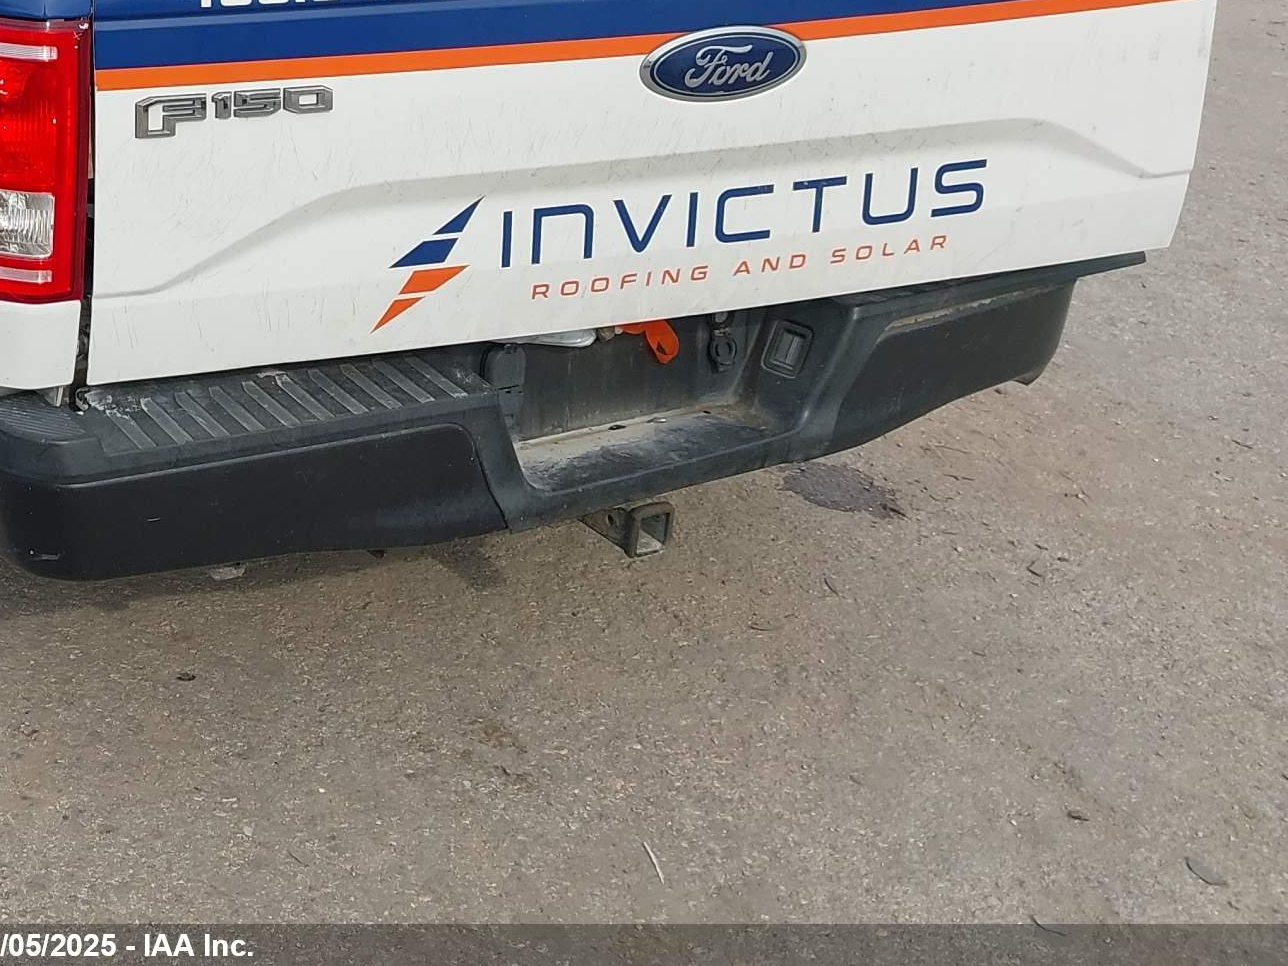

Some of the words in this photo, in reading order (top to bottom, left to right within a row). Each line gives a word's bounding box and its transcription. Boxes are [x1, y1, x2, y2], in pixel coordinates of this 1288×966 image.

[500, 158, 988, 268] INVICTUS
[531, 264, 709, 301] ROOFING
[733, 252, 807, 277] AND
[830, 234, 950, 265] SOLAR
